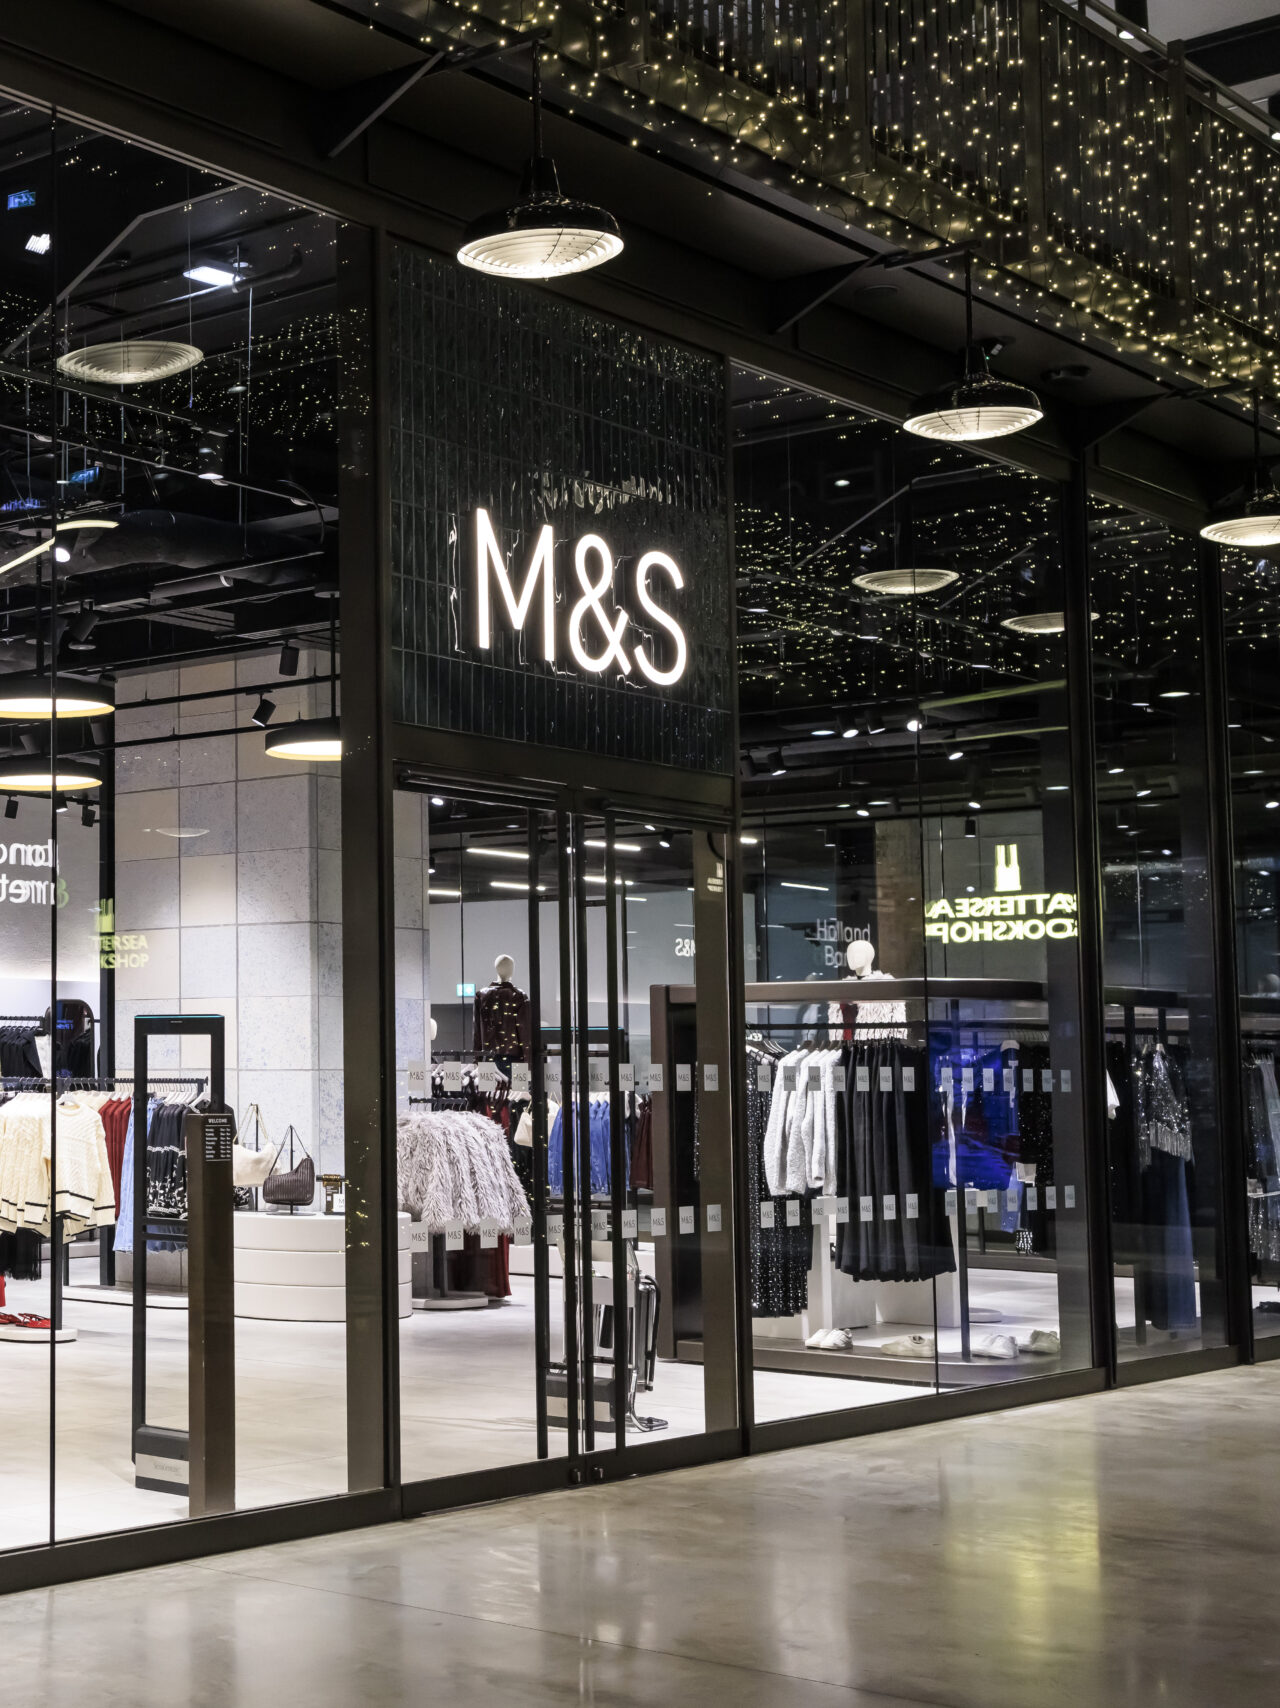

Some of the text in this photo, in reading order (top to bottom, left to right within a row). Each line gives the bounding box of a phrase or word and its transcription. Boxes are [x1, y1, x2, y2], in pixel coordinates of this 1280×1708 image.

[475, 507, 688, 686] M&S
[410, 1072, 424, 1080] M&S
[446, 1072, 460, 1080] M&S
[480, 1072, 494, 1081] M&S
[513, 1073, 527, 1081] M&S
[546, 1073, 559, 1081] M&S
[482, 1229, 496, 1237] M&S
[515, 1227, 529, 1236] M&S
[549, 1225, 561, 1234] M&S
[411, 1233, 426, 1242] M&S
[448, 1231, 462, 1239] M&S
